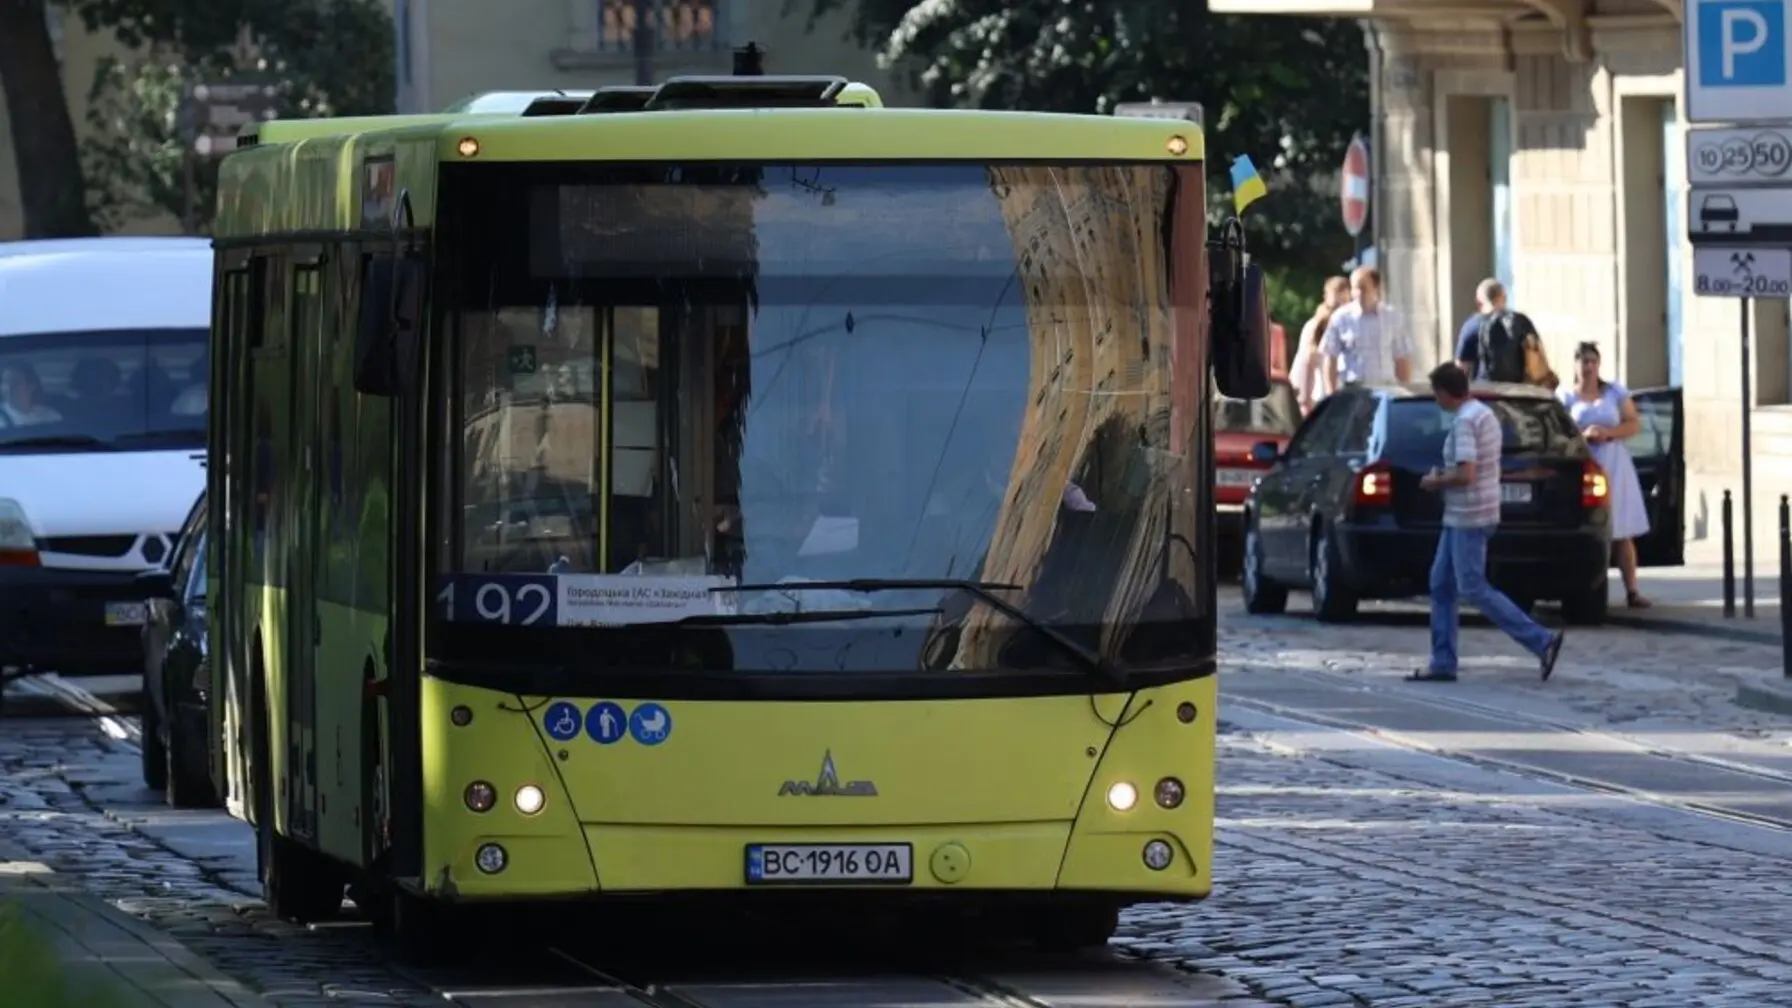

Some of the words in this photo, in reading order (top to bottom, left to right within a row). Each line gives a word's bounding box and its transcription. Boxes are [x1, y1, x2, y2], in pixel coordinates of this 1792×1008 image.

[1720, 8, 1768, 80] P
[1700, 150, 1718, 166] 10
[1726, 147, 1748, 167] 25
[1755, 143, 1785, 166] 50
[435, 581, 551, 626] 192
[764, 850, 799, 875] BC
[806, 850, 859, 875] 1916
[864, 850, 900, 874] OA
